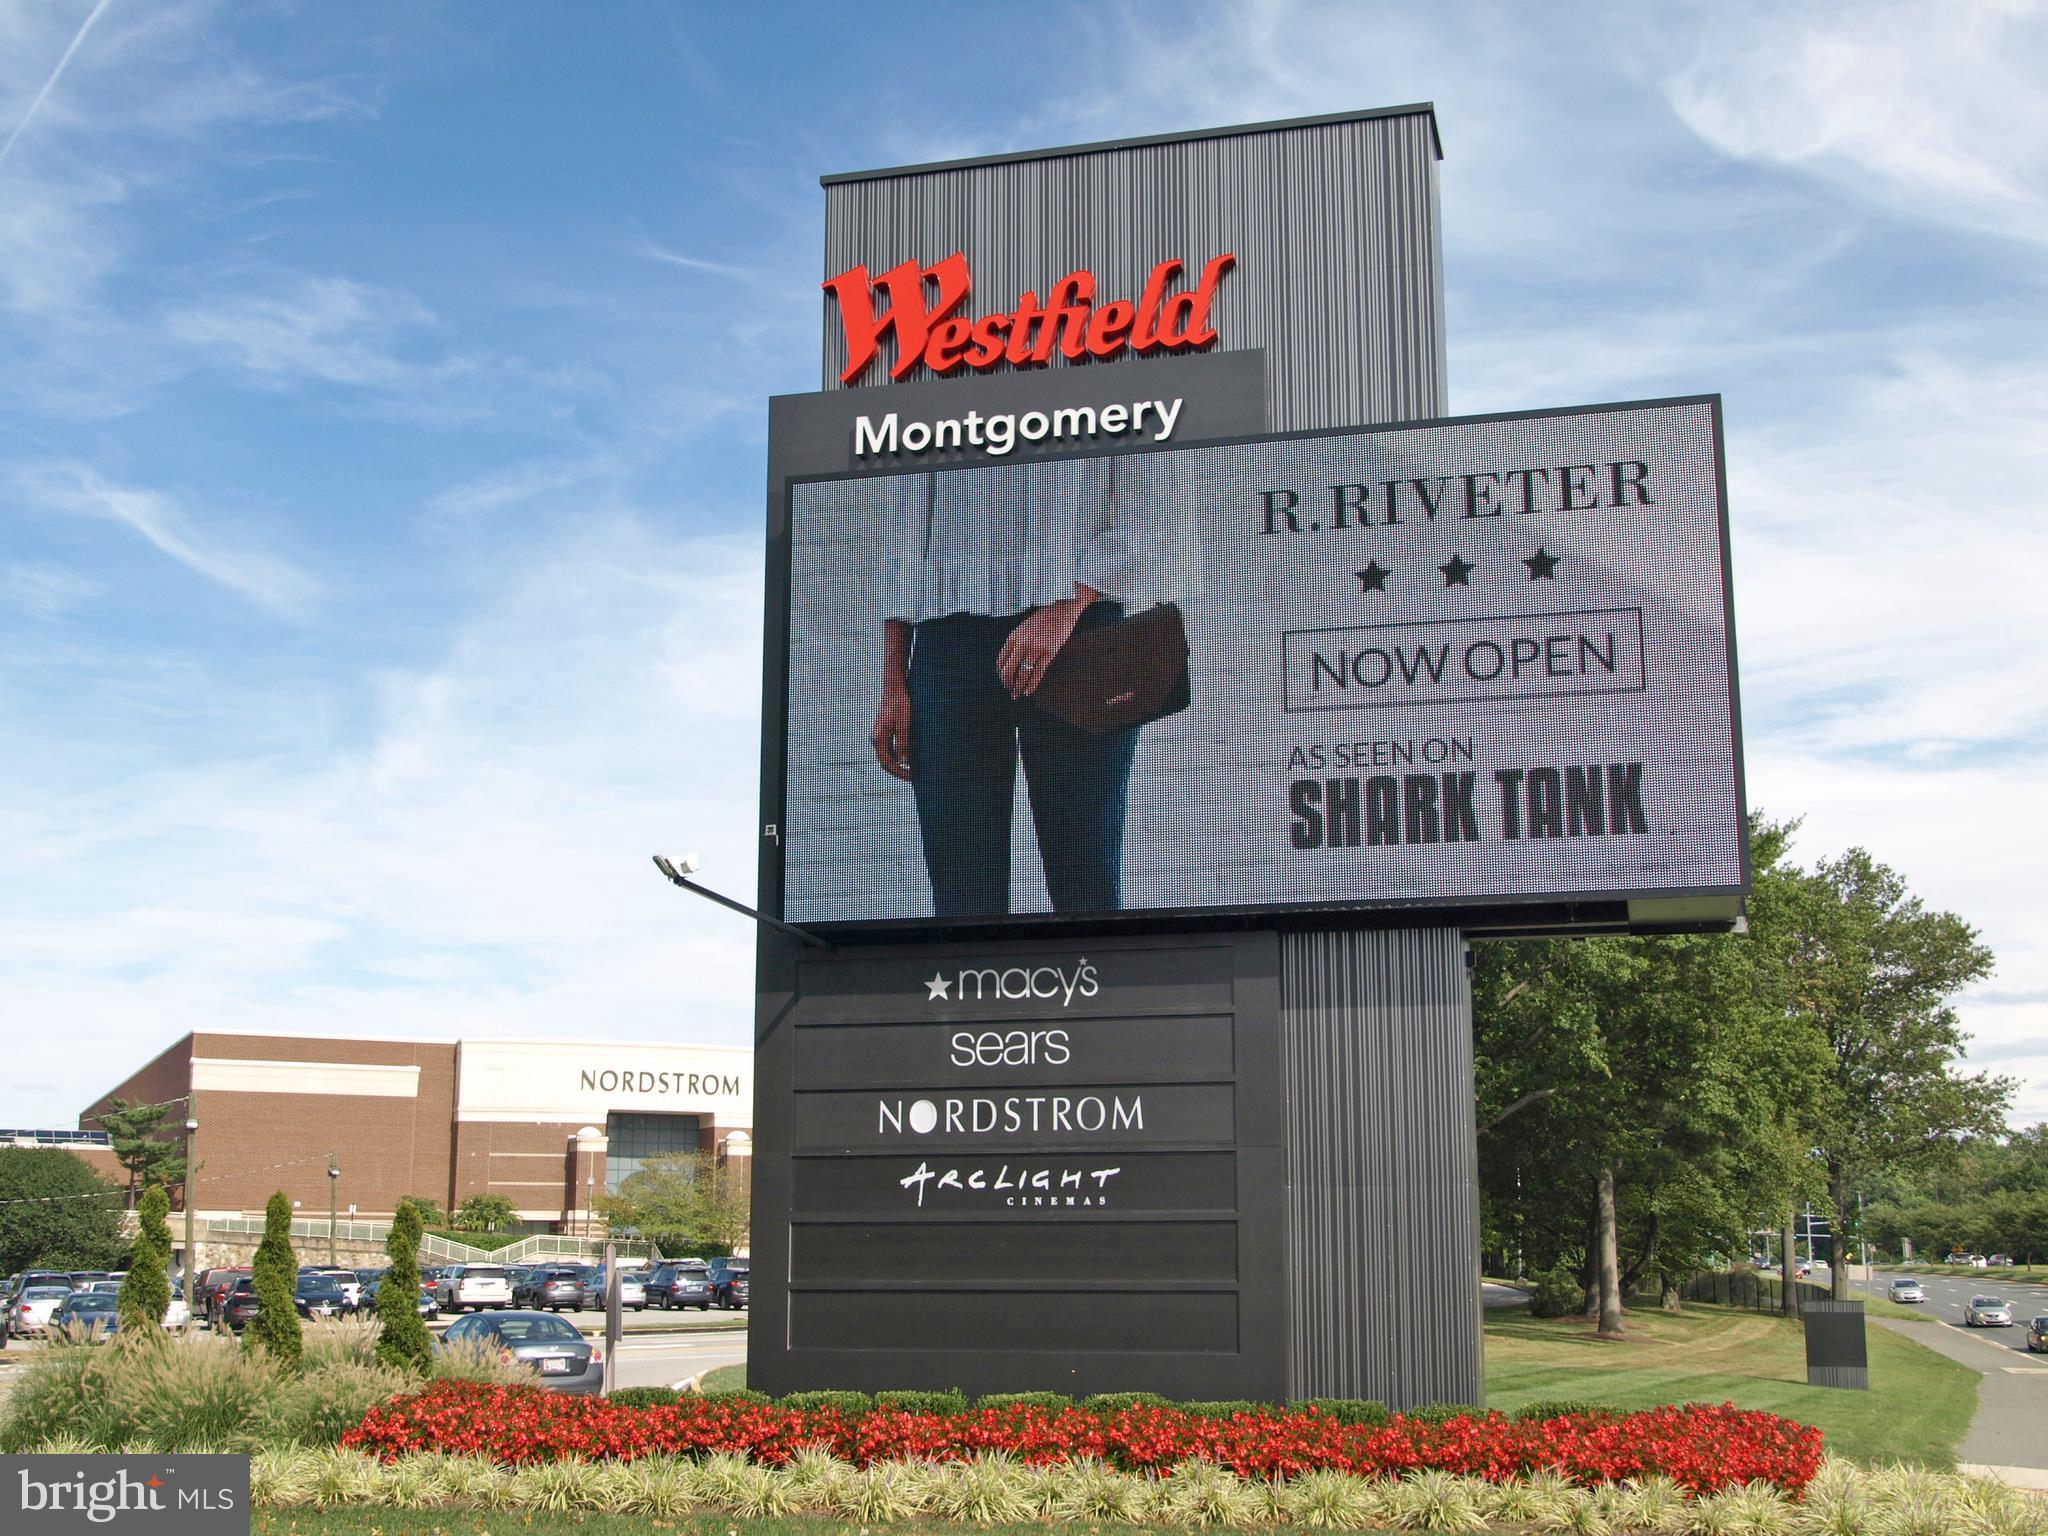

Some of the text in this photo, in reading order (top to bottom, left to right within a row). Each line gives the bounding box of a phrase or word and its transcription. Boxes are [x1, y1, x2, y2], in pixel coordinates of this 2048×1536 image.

[821, 250, 1237, 384] Westfield
[854, 397, 1184, 456] Montgomery
[1258, 460, 1656, 535] R.RIVETER
[1312, 632, 1617, 691] NOW OPEN
[1288, 735, 1474, 771] AS SEEN ON
[1289, 762, 1649, 850] SHARK TANK
[957, 957, 1099, 1007] macy's
[951, 1029, 1071, 1067] sears
[580, 1069, 740, 1096] NORDSTROM
[879, 1095, 1144, 1134] NORDSTROM
[1006, 1196, 1107, 1206] CINEMAS
